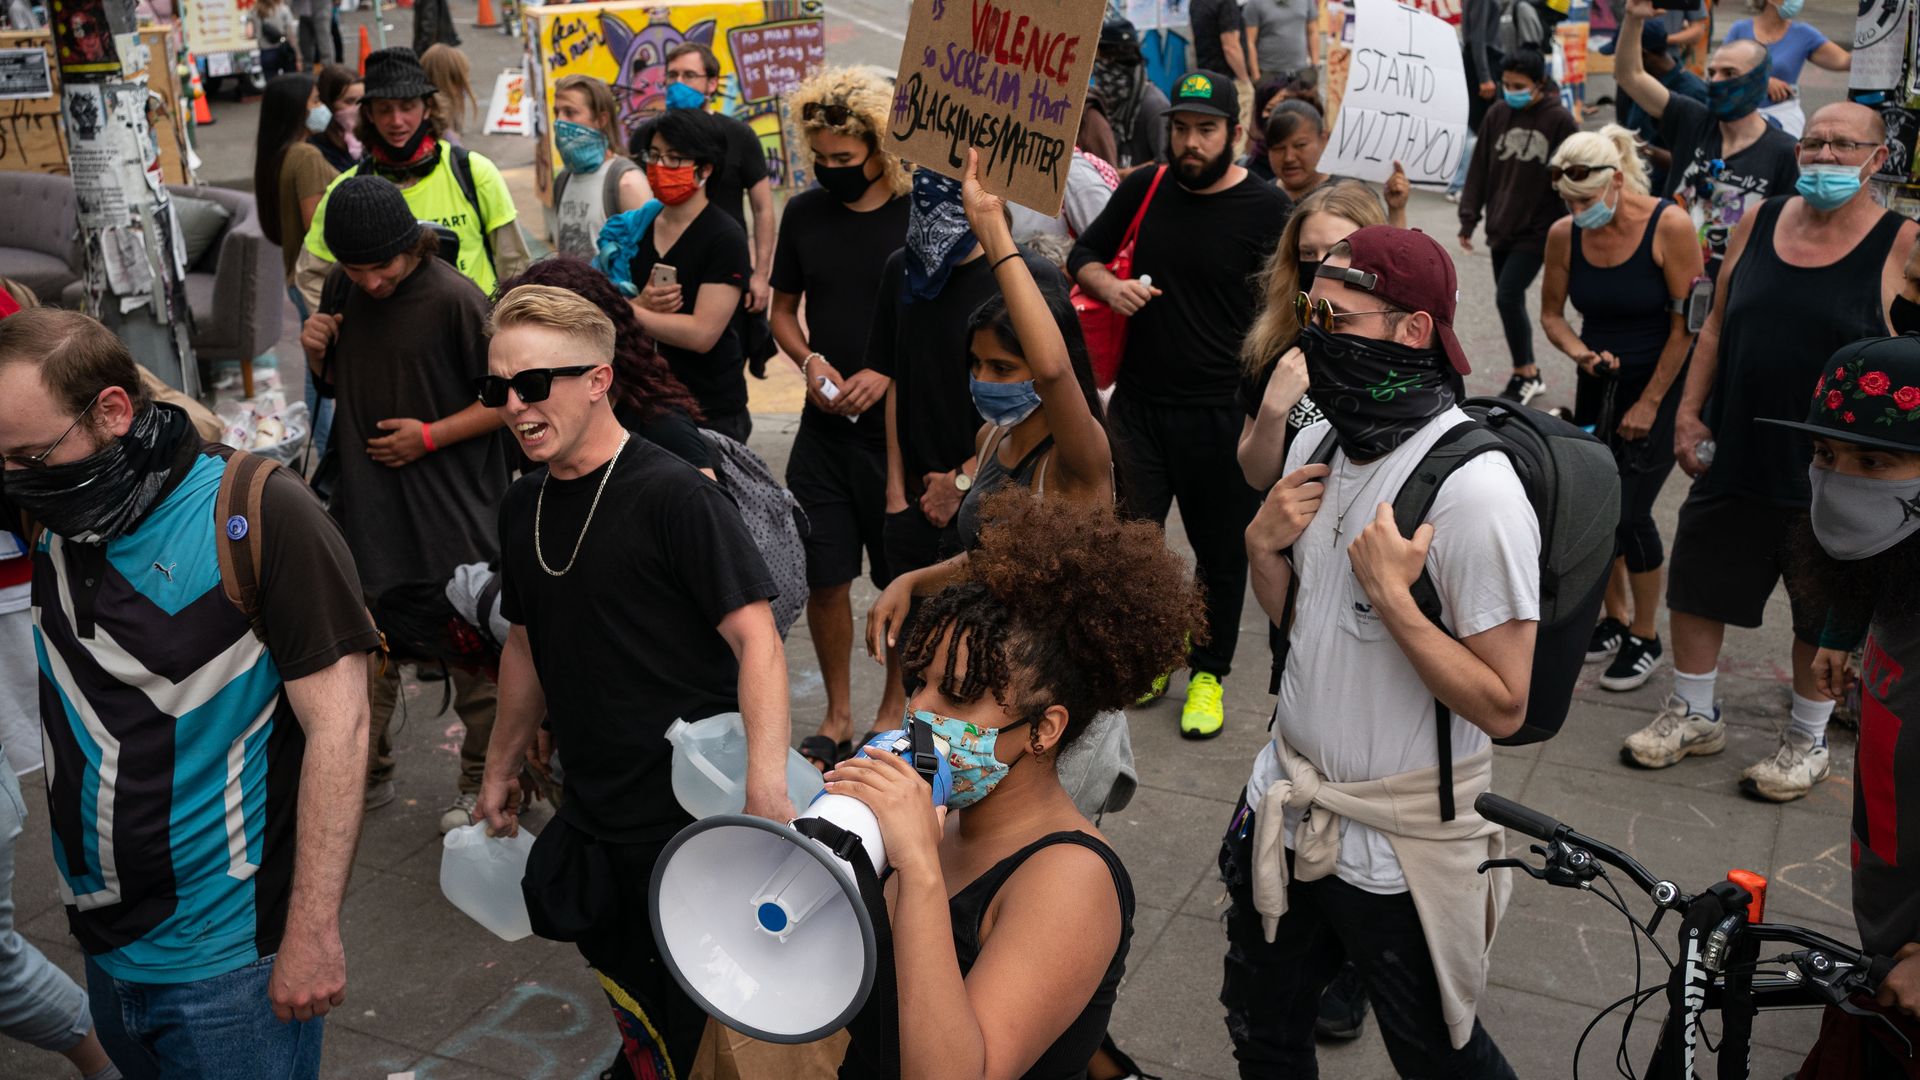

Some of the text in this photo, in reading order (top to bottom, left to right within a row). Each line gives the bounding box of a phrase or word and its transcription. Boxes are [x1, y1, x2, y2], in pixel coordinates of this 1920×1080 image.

[971, 0, 1081, 87] VIOLENCE
[1398, 5, 1425, 59] I
[939, 42, 1021, 111] SCREAM
[1028, 76, 1072, 125] that
[1354, 48, 1435, 104] STAND
[892, 72, 1065, 194] #BLACKLIVESMATTER
[1338, 106, 1465, 180] WITH YOU
[433, 214, 467, 228] ART
